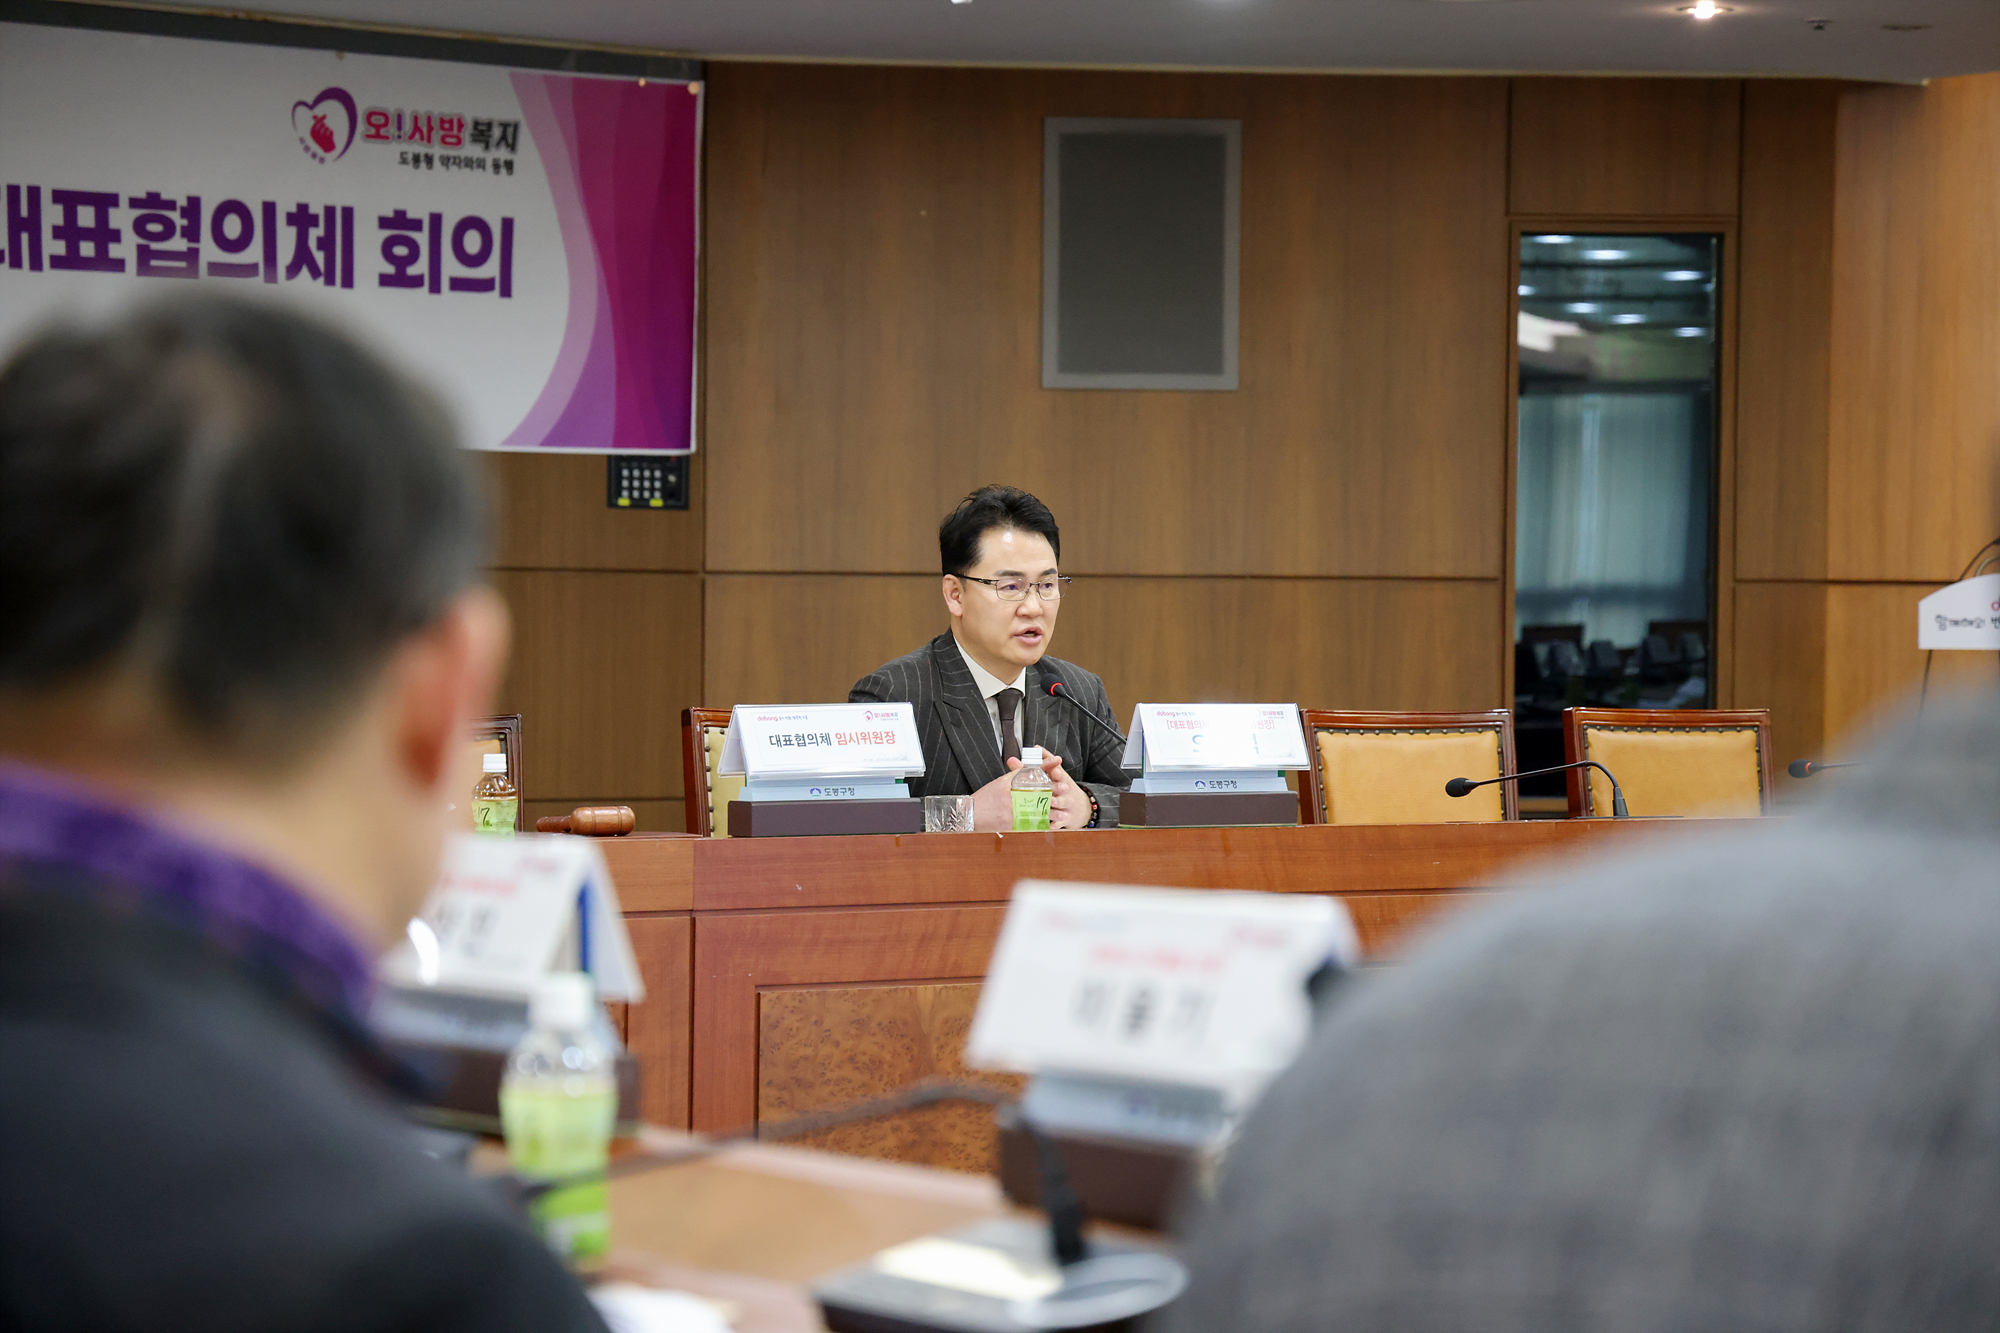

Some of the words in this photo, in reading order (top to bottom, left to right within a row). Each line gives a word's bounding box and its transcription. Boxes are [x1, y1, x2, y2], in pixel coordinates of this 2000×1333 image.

[492, 158, 514, 175] 동행
[377, 208, 515, 298] 회의
[769, 732, 832, 748] 대표협의체
[835, 730, 896, 746] 임시위원장
[824, 787, 855, 796] 도봉구청
[1209, 780, 1238, 789] 도봉구청
